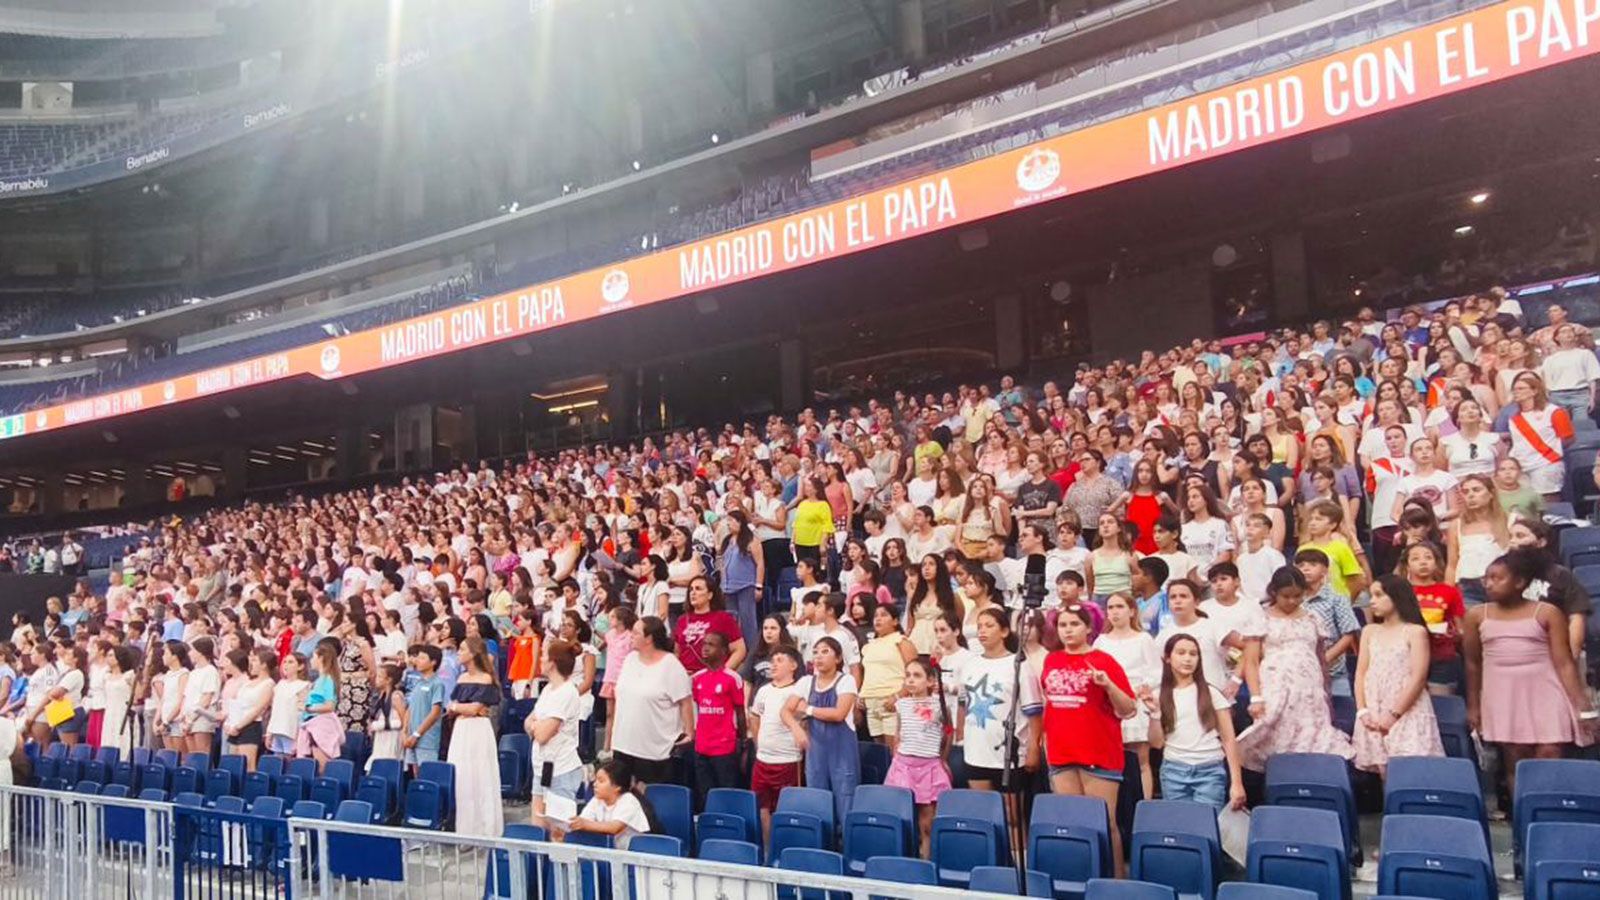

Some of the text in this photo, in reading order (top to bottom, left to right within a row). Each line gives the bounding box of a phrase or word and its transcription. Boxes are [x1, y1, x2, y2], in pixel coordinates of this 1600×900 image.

[1147, 76, 1305, 165] MADRID
[1322, 41, 1416, 117] CON
[1436, 22, 1489, 86] EL
[127, 148, 169, 170] Bernabéu
[680, 178, 957, 289] MADRID CON EL PAPA
[381, 287, 566, 362] MADRID CON EL PAPA
[196, 354, 289, 393] MADRID CON EL PAPA
[64, 400, 94, 422] MADRID
[95, 396, 111, 417] CON
[123, 390, 143, 412] PAPA
